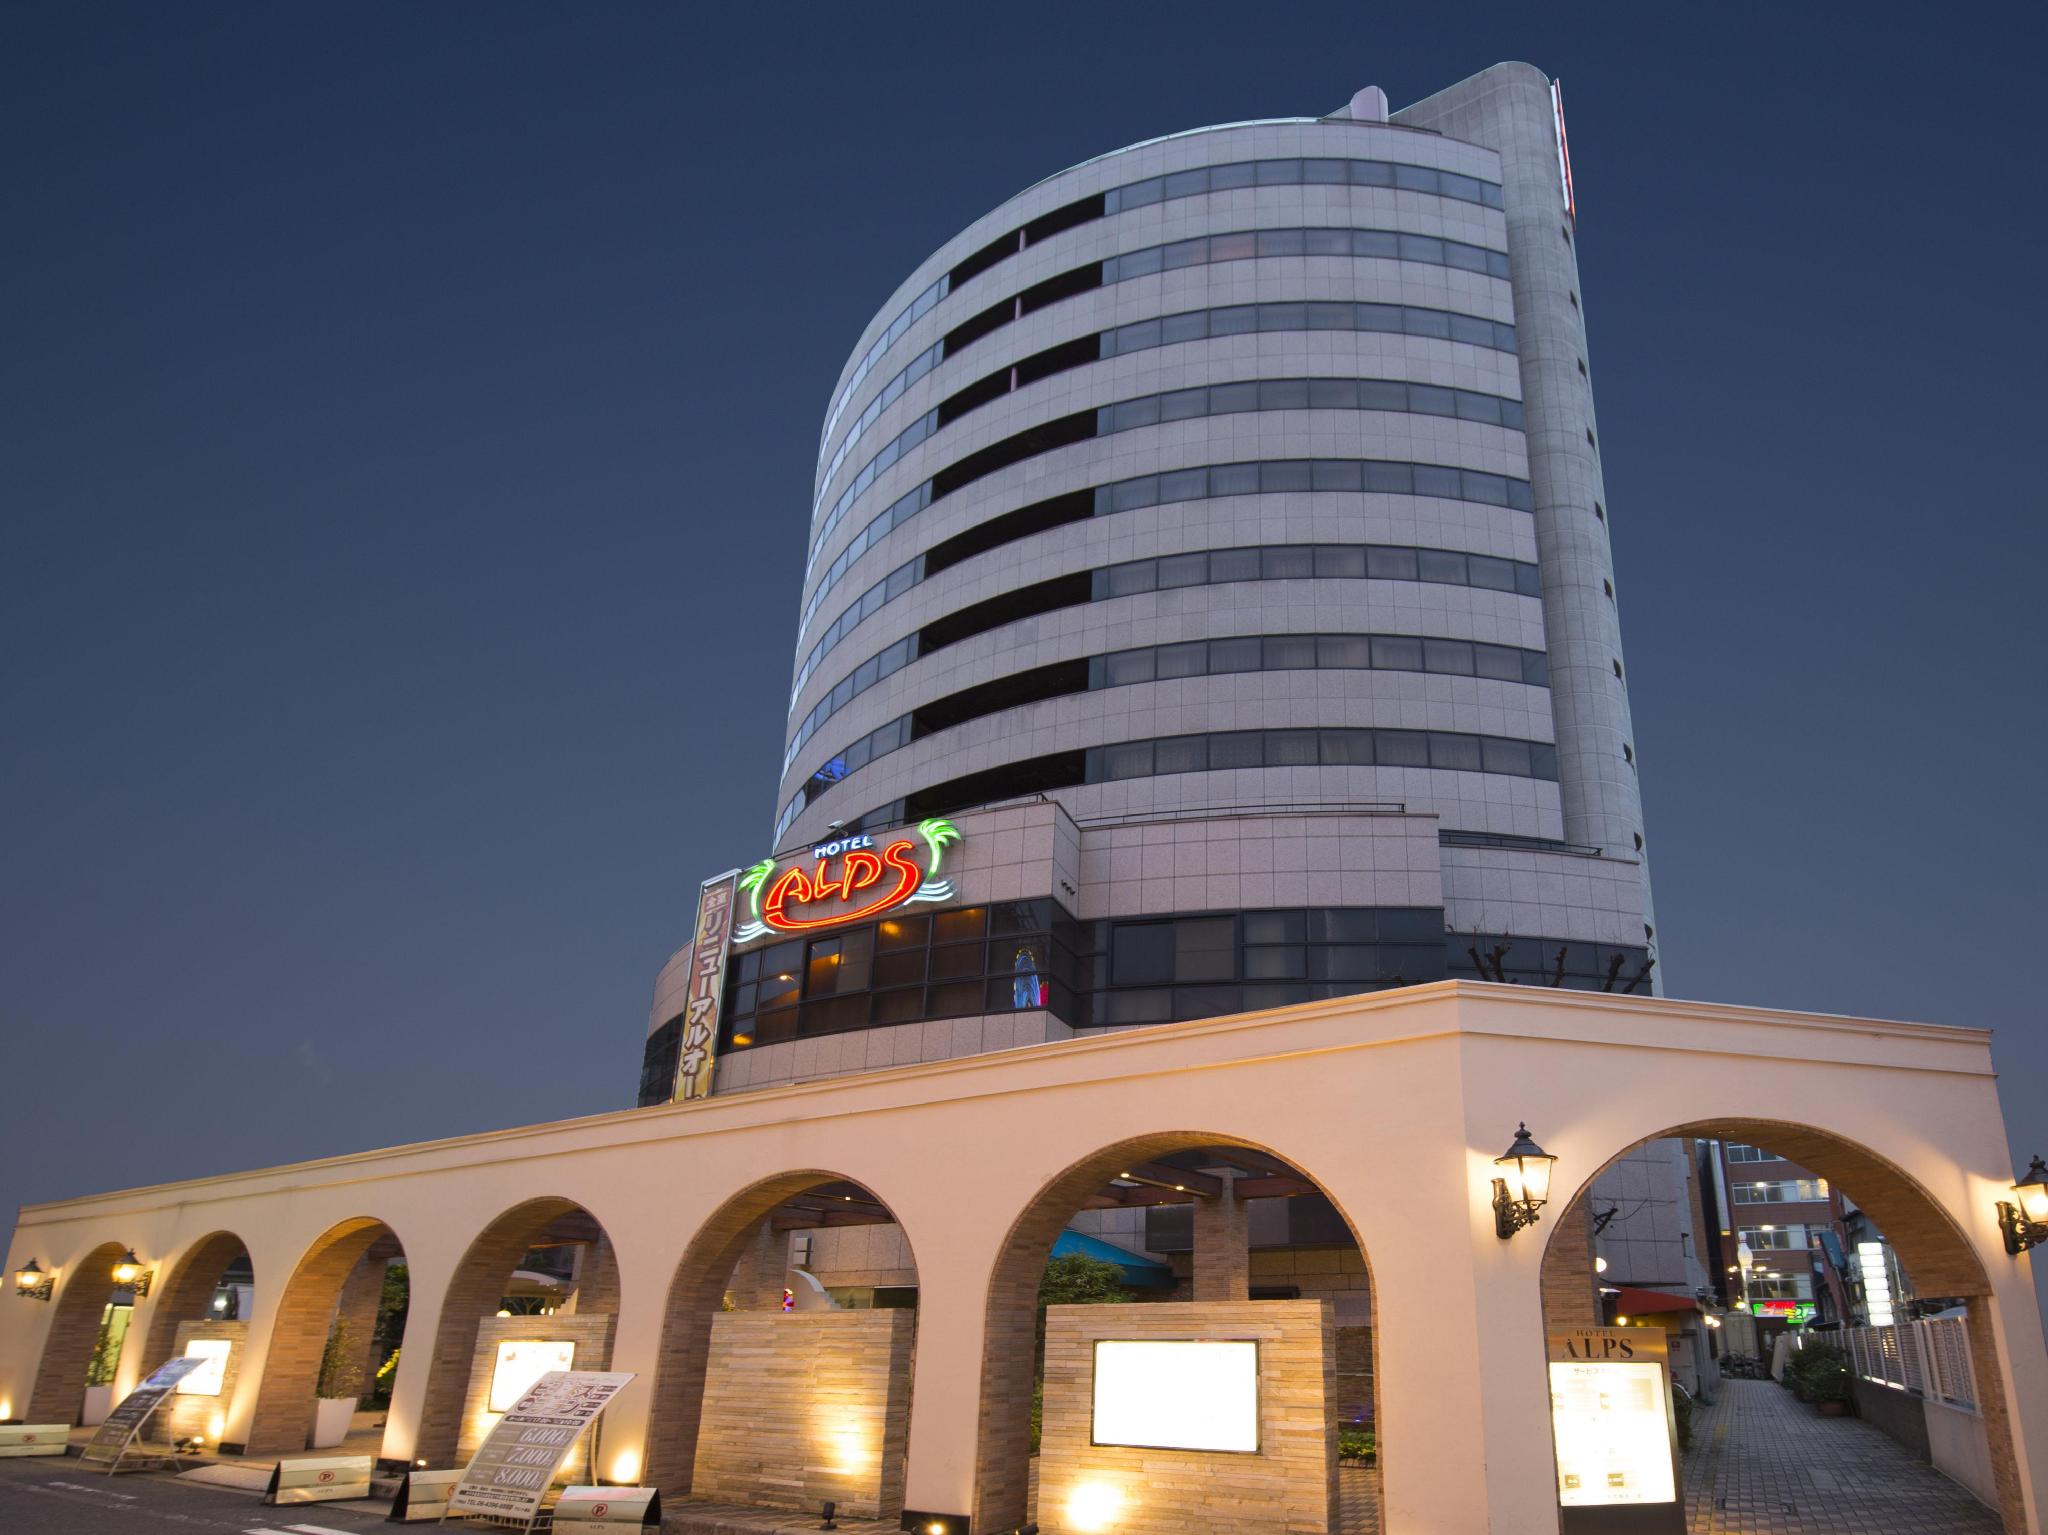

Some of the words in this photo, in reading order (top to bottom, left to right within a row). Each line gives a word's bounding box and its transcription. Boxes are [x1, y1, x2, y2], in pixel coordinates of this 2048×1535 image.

[814, 835, 872, 858] HOTEL
[764, 841, 919, 929] ALPS
[1576, 1329, 1617, 1337] HOTEL
[1562, 1338, 1634, 1359] ALPS
